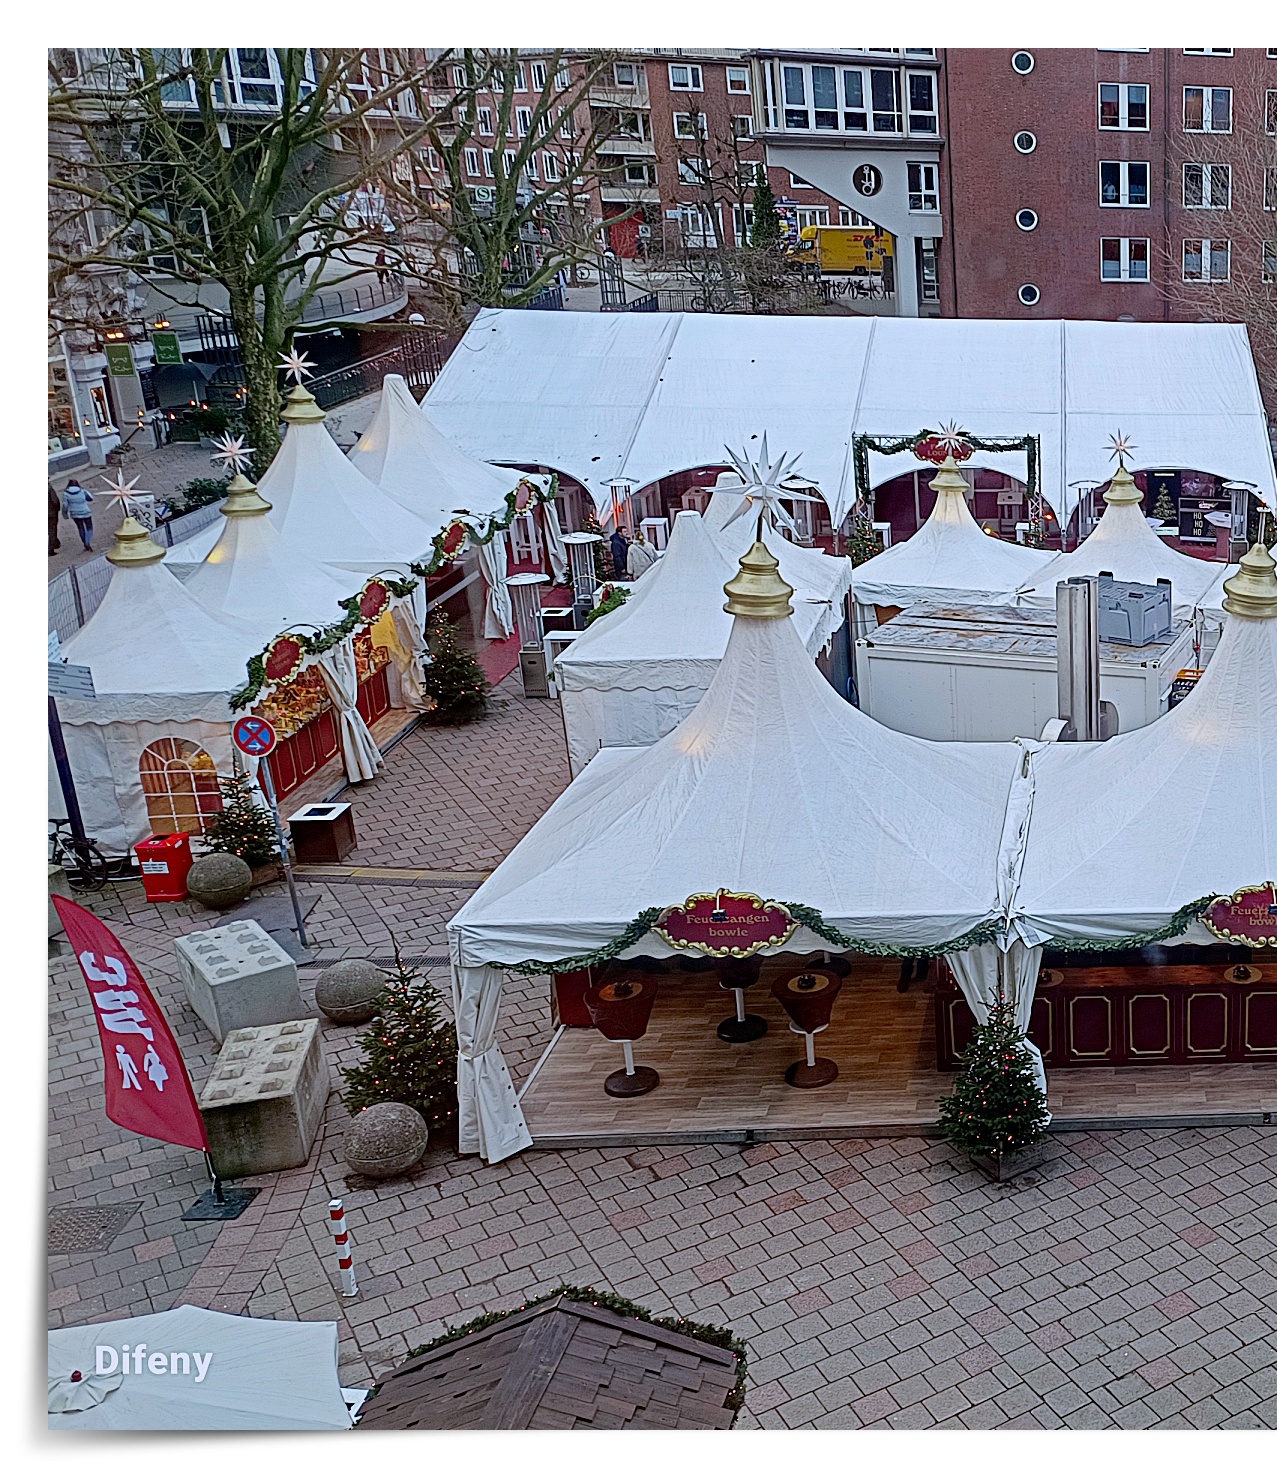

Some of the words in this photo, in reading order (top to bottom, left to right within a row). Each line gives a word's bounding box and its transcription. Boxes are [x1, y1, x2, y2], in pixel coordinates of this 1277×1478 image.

[928, 449, 959, 457] LOUNE
[1193, 512, 1203, 520] HO
[1194, 520, 1204, 528] HO
[1193, 528, 1203, 536] HO
[686, 914, 770, 925] Feuezangen
[709, 927, 749, 937] bowle
